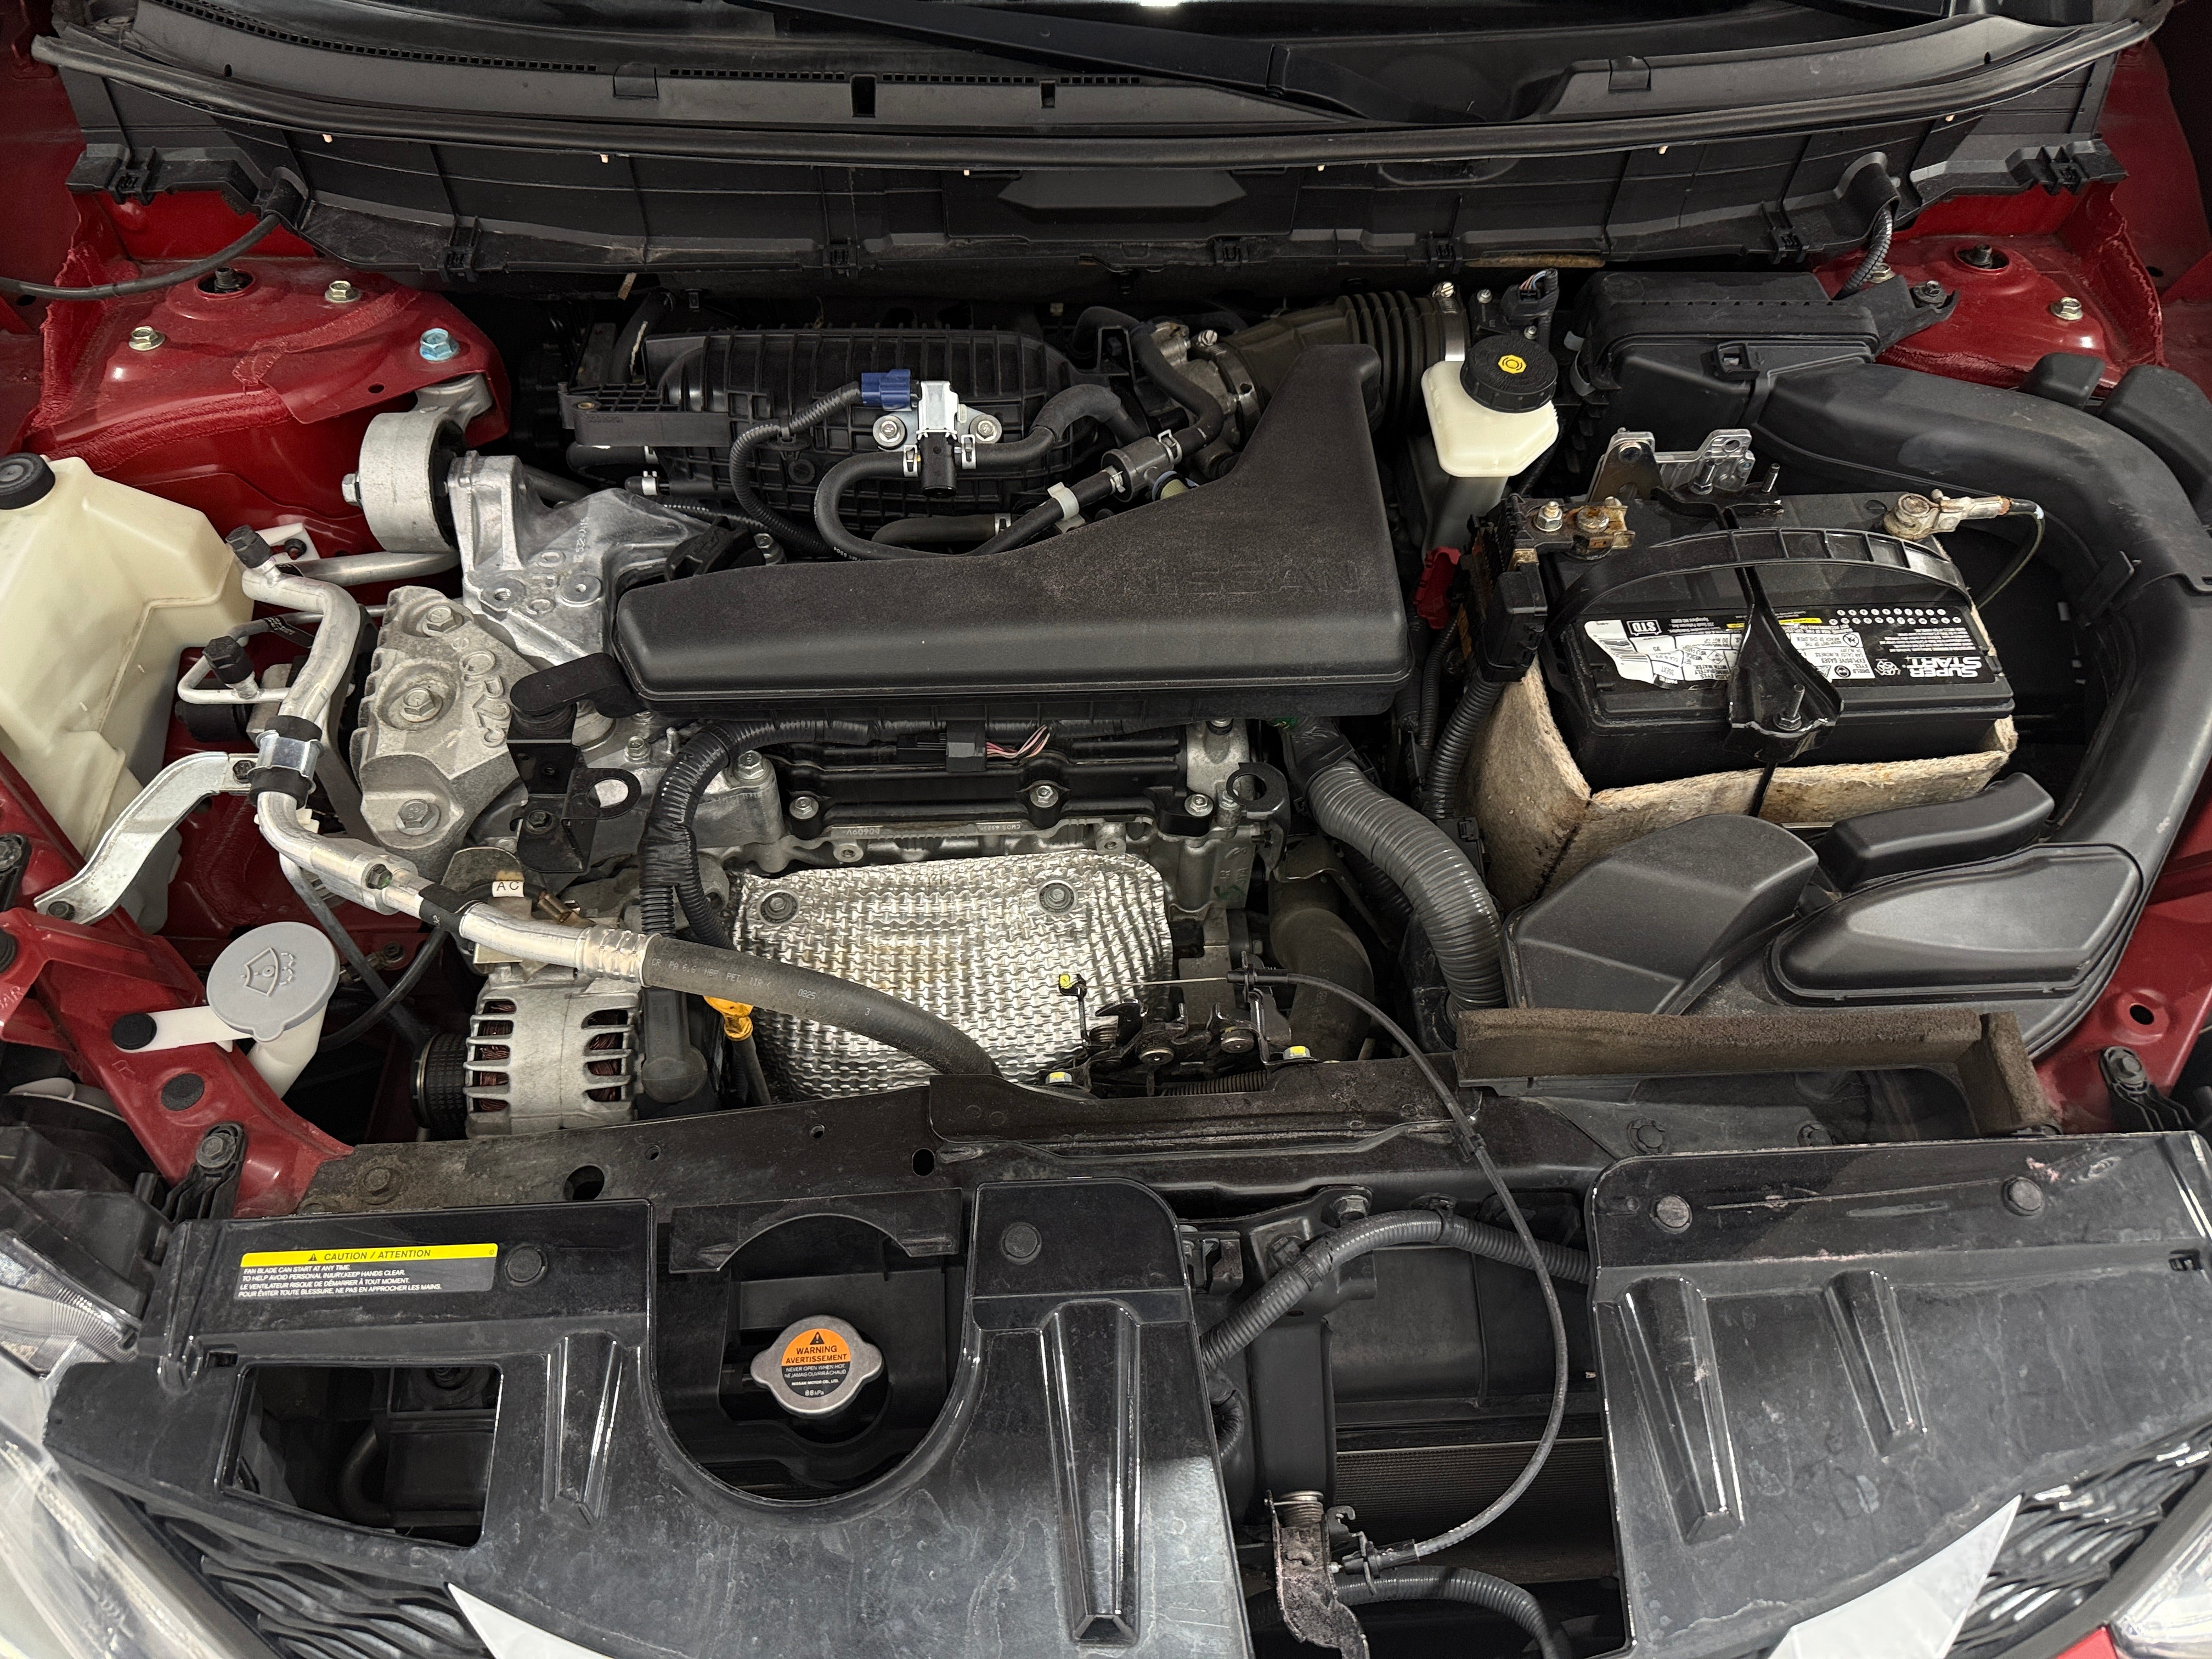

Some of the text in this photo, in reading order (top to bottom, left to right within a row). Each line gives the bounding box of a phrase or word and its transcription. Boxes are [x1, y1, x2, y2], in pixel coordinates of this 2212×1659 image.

[1122, 560, 1362, 597] NISSAN
[1632, 621, 1656, 633] STD
[1906, 656, 1982, 669] START
[1909, 667, 1978, 678] SUPER
[459, 650, 511, 749] QR25
[324, 1251, 367, 1261] CAUTION
[377, 1249, 431, 1259] ATTENTION
[796, 1345, 838, 1355] WARNING
[785, 1353, 848, 1364] AVERTISSEMENT
